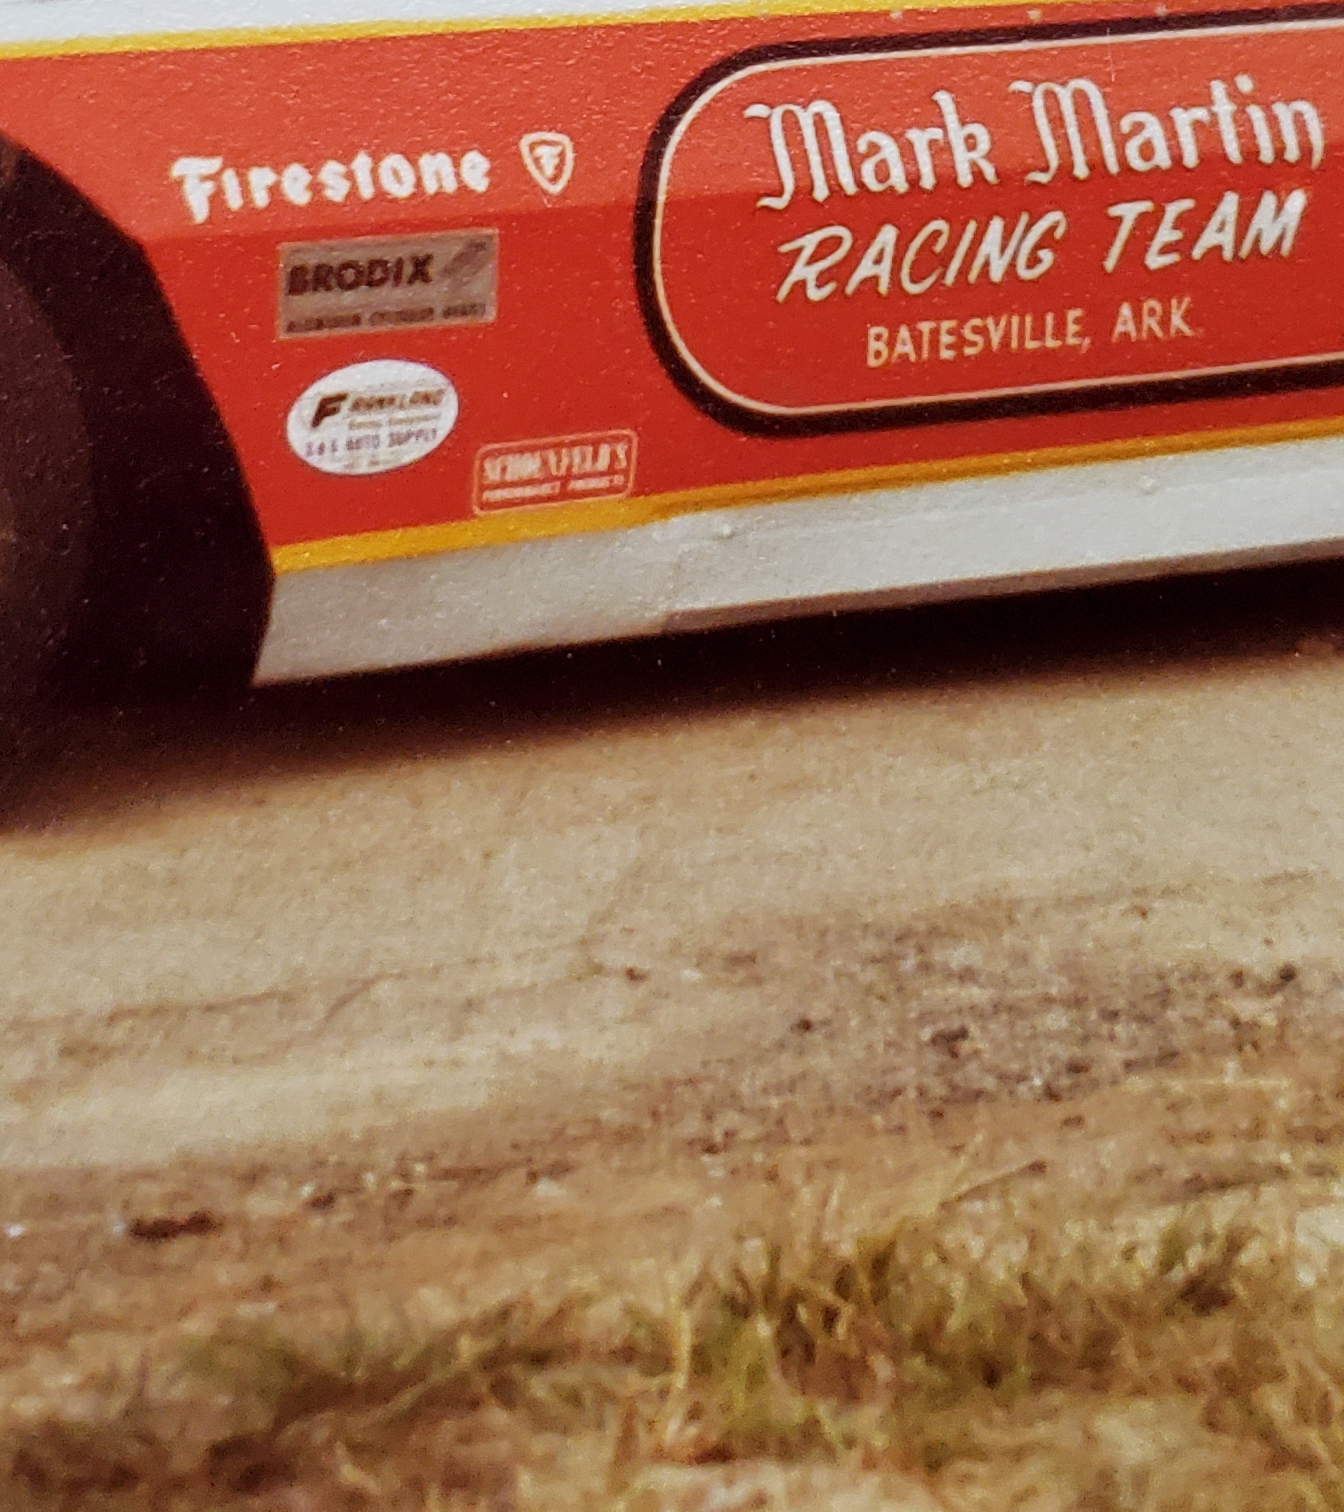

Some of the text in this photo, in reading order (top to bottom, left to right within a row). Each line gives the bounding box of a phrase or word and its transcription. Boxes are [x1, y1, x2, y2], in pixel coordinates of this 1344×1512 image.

[743, 72, 1327, 210] Mark Martin
[169, 149, 492, 225] Firestone
[286, 252, 436, 297] BRODIX
[775, 187, 1309, 303] RACING TEAM
[866, 307, 1092, 368] BATESVILLE,
